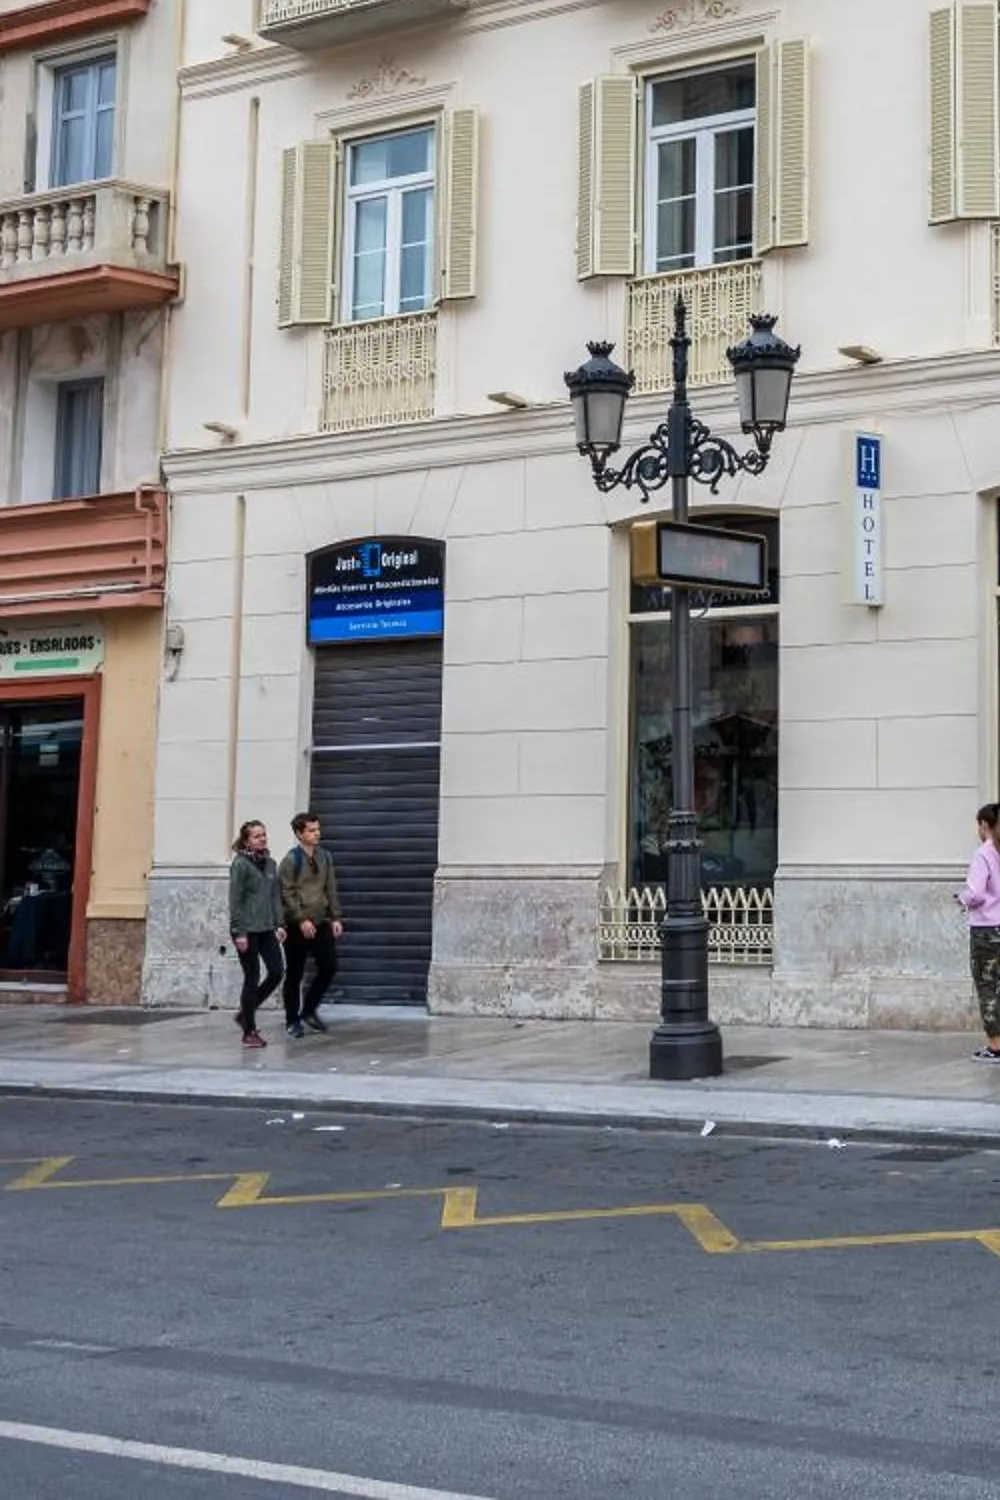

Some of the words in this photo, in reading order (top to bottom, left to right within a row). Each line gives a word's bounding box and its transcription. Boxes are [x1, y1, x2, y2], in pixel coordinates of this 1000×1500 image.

[861, 445, 876, 473] H
[862, 493, 876, 601] HOTEL
[381, 550, 418, 569] Original
[30, 635, 95, 654] ENSALADAS
